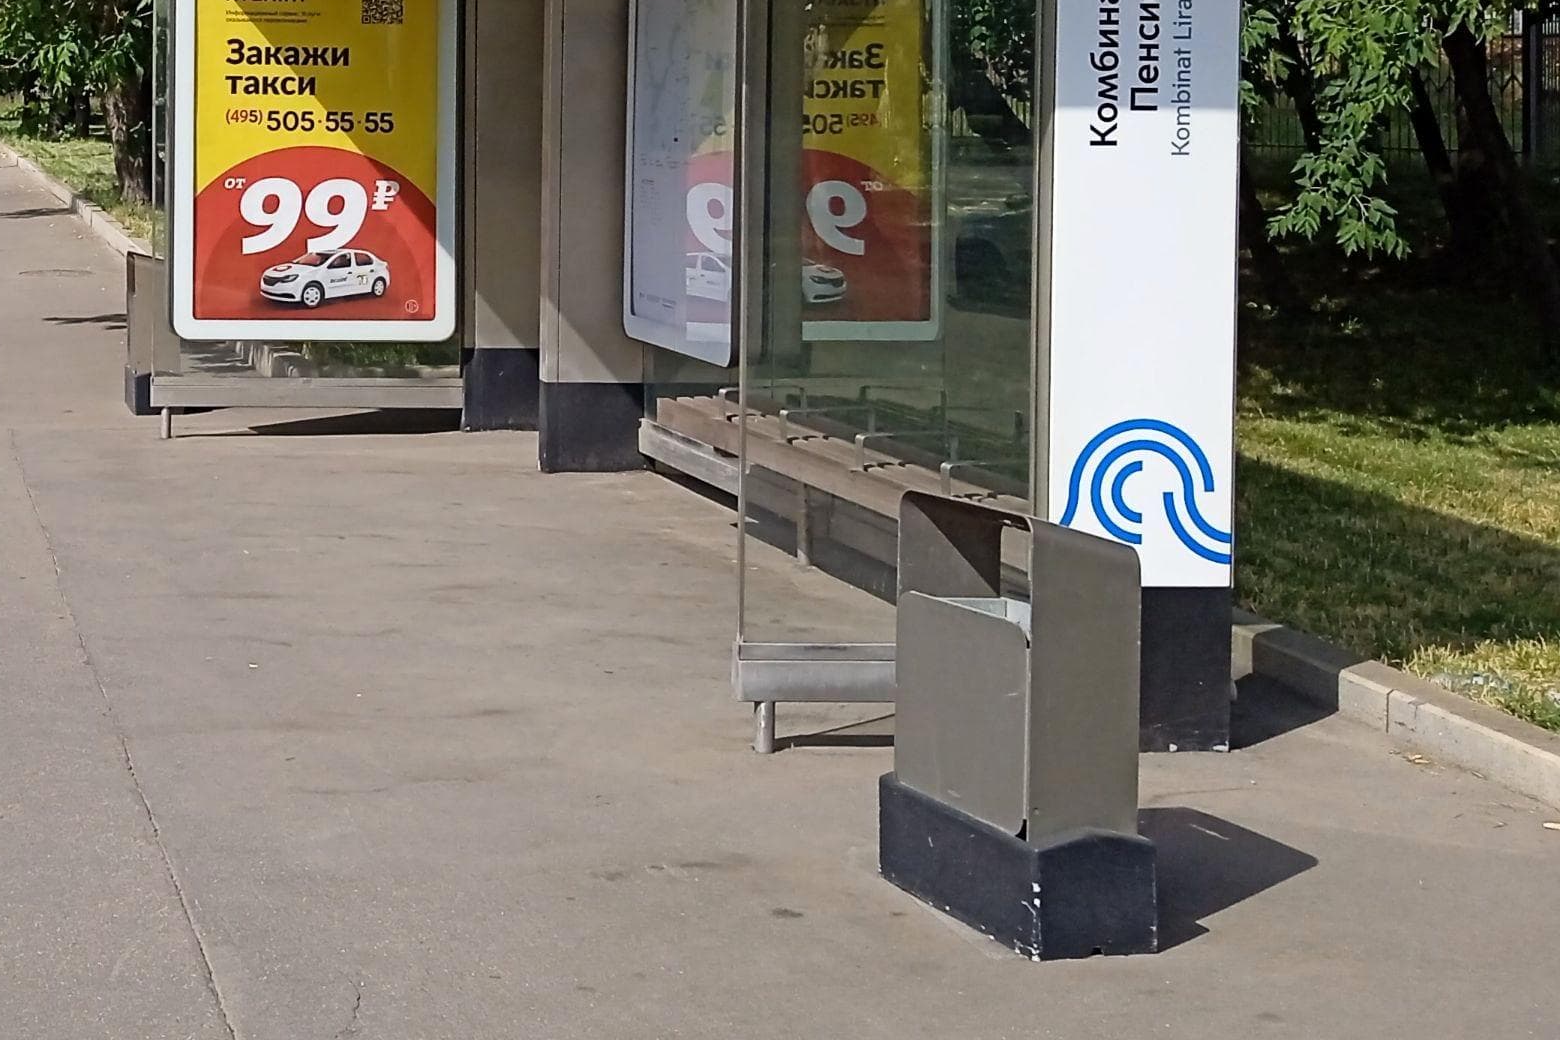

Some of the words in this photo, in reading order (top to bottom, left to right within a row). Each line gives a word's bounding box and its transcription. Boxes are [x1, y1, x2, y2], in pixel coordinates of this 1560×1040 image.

[225, 38, 350, 67] Закажи
[225, 75, 316, 96] такси
[1171, 47, 1192, 156] Kombinat
[225, 109, 263, 125] (495)
